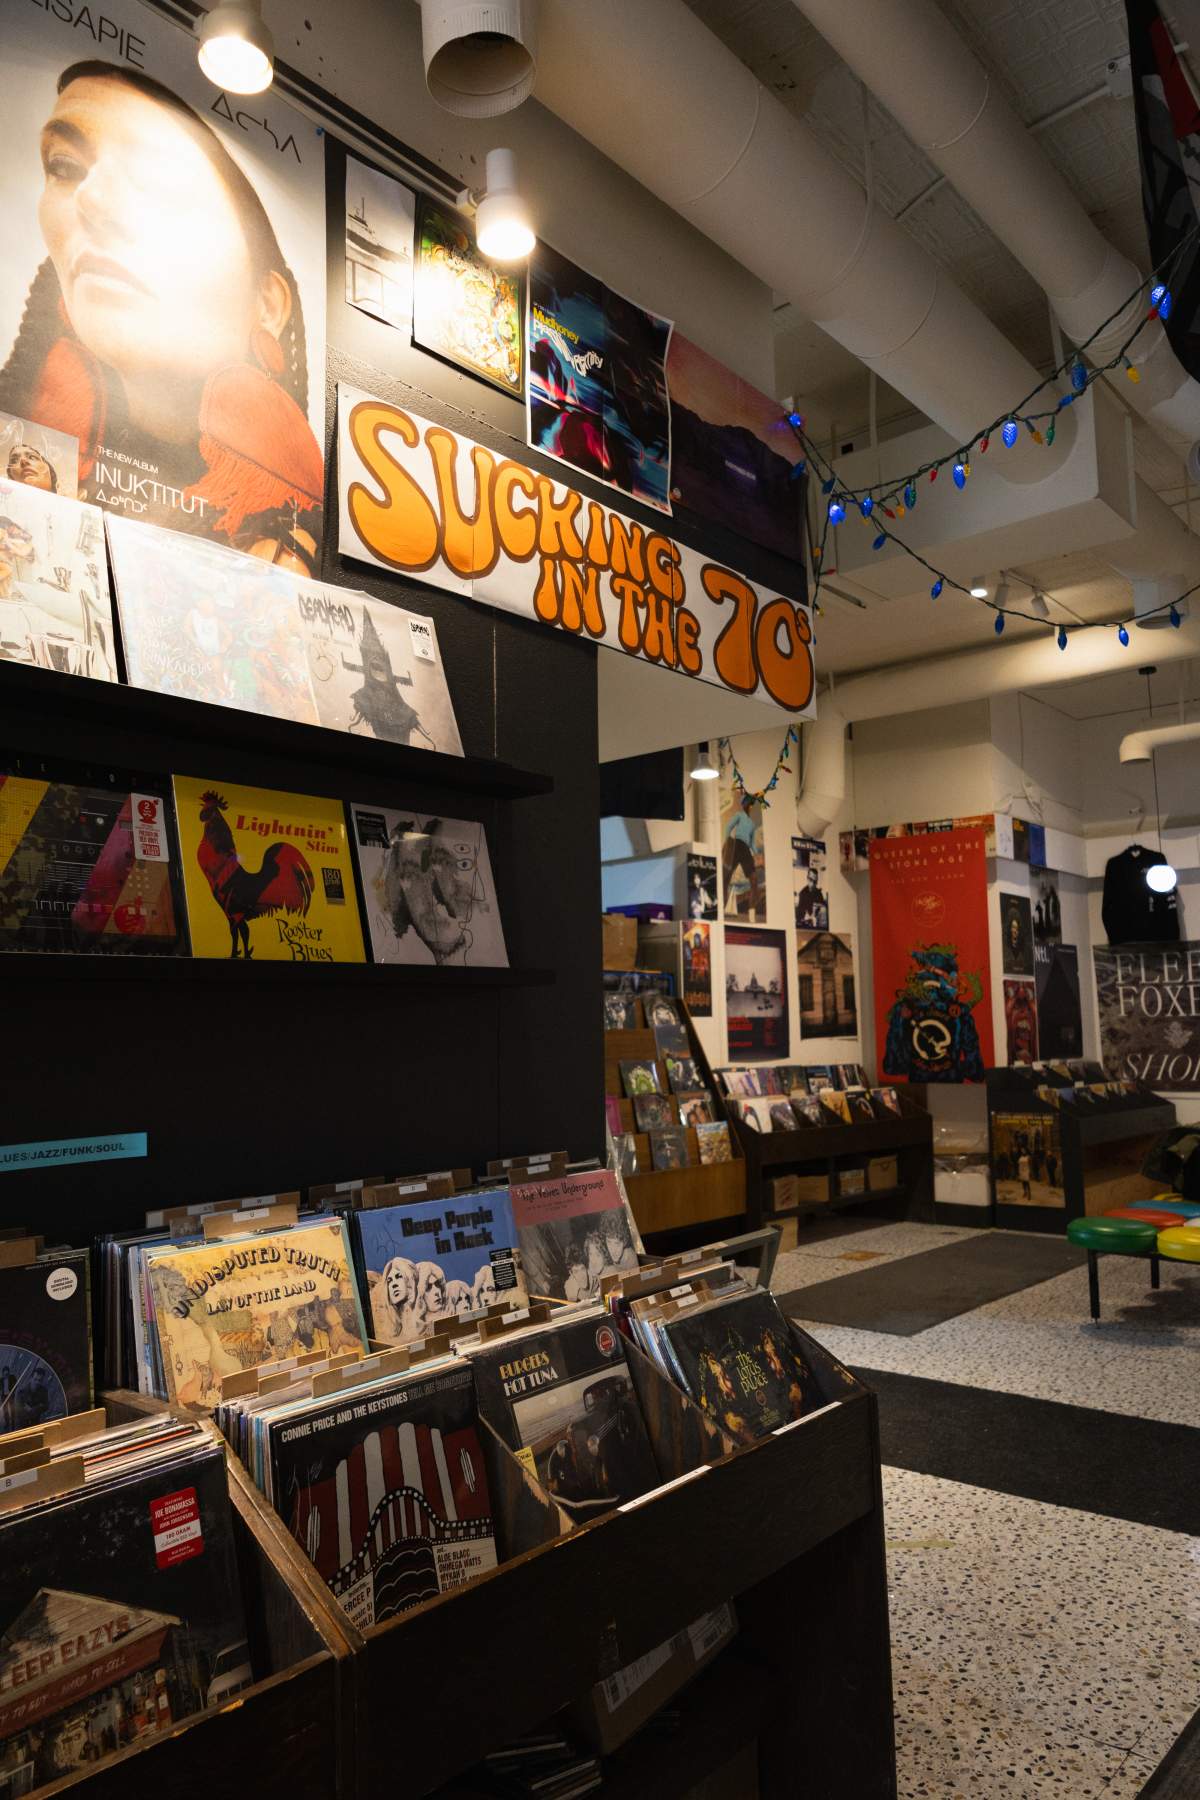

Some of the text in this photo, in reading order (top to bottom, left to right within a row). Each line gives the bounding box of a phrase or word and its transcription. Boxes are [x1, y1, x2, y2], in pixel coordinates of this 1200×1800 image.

[32, 0, 146, 69] SAPIE
[532, 306, 580, 344] Mudhoney
[97, 445, 159, 474] THE NEW ALBUM
[95, 461, 209, 518] INUKTITUT
[348, 401, 686, 606] SUCKING
[534, 559, 703, 676] IN THE
[236, 815, 334, 840] Lightnin'
[305, 840, 339, 855] Slim
[874, 840, 981, 861] QUEENS OF THE
[324, 869, 340, 880] 180
[889, 855, 964, 870] STONE AGE
[276, 918, 323, 944] Rooster
[289, 941, 334, 961] Blues
[561, 1180, 604, 1198] Underground
[401, 1207, 493, 1237] Deep Purple
[435, 1228, 494, 1255] in Rock
[174, 1246, 341, 1319] UNDISPUTED TRUTH
[207, 1280, 317, 1316] LAW OF THE LAND
[498, 1350, 550, 1380] BURGERS
[736, 1350, 753, 1367] the
[503, 1366, 559, 1397] HOT TUNA
[281, 1423, 311, 1443] CONNIE
[312, 1416, 336, 1437] PRICE
[336, 1409, 352, 1425] AND
[352, 1404, 366, 1421] THE
[367, 1391, 408, 1416] KEYSTONES
[154, 1508, 164, 1519] JOE
[164, 1497, 196, 1514] BONAMASSA
[175, 1526, 191, 1536] GRAM
[437, 1548, 470, 1563] ALOE BLACC
[439, 1556, 482, 1573] OHMEGA WATTS
[366, 1587, 371, 1598] P
[60, 1614, 129, 1665] EAZYS
